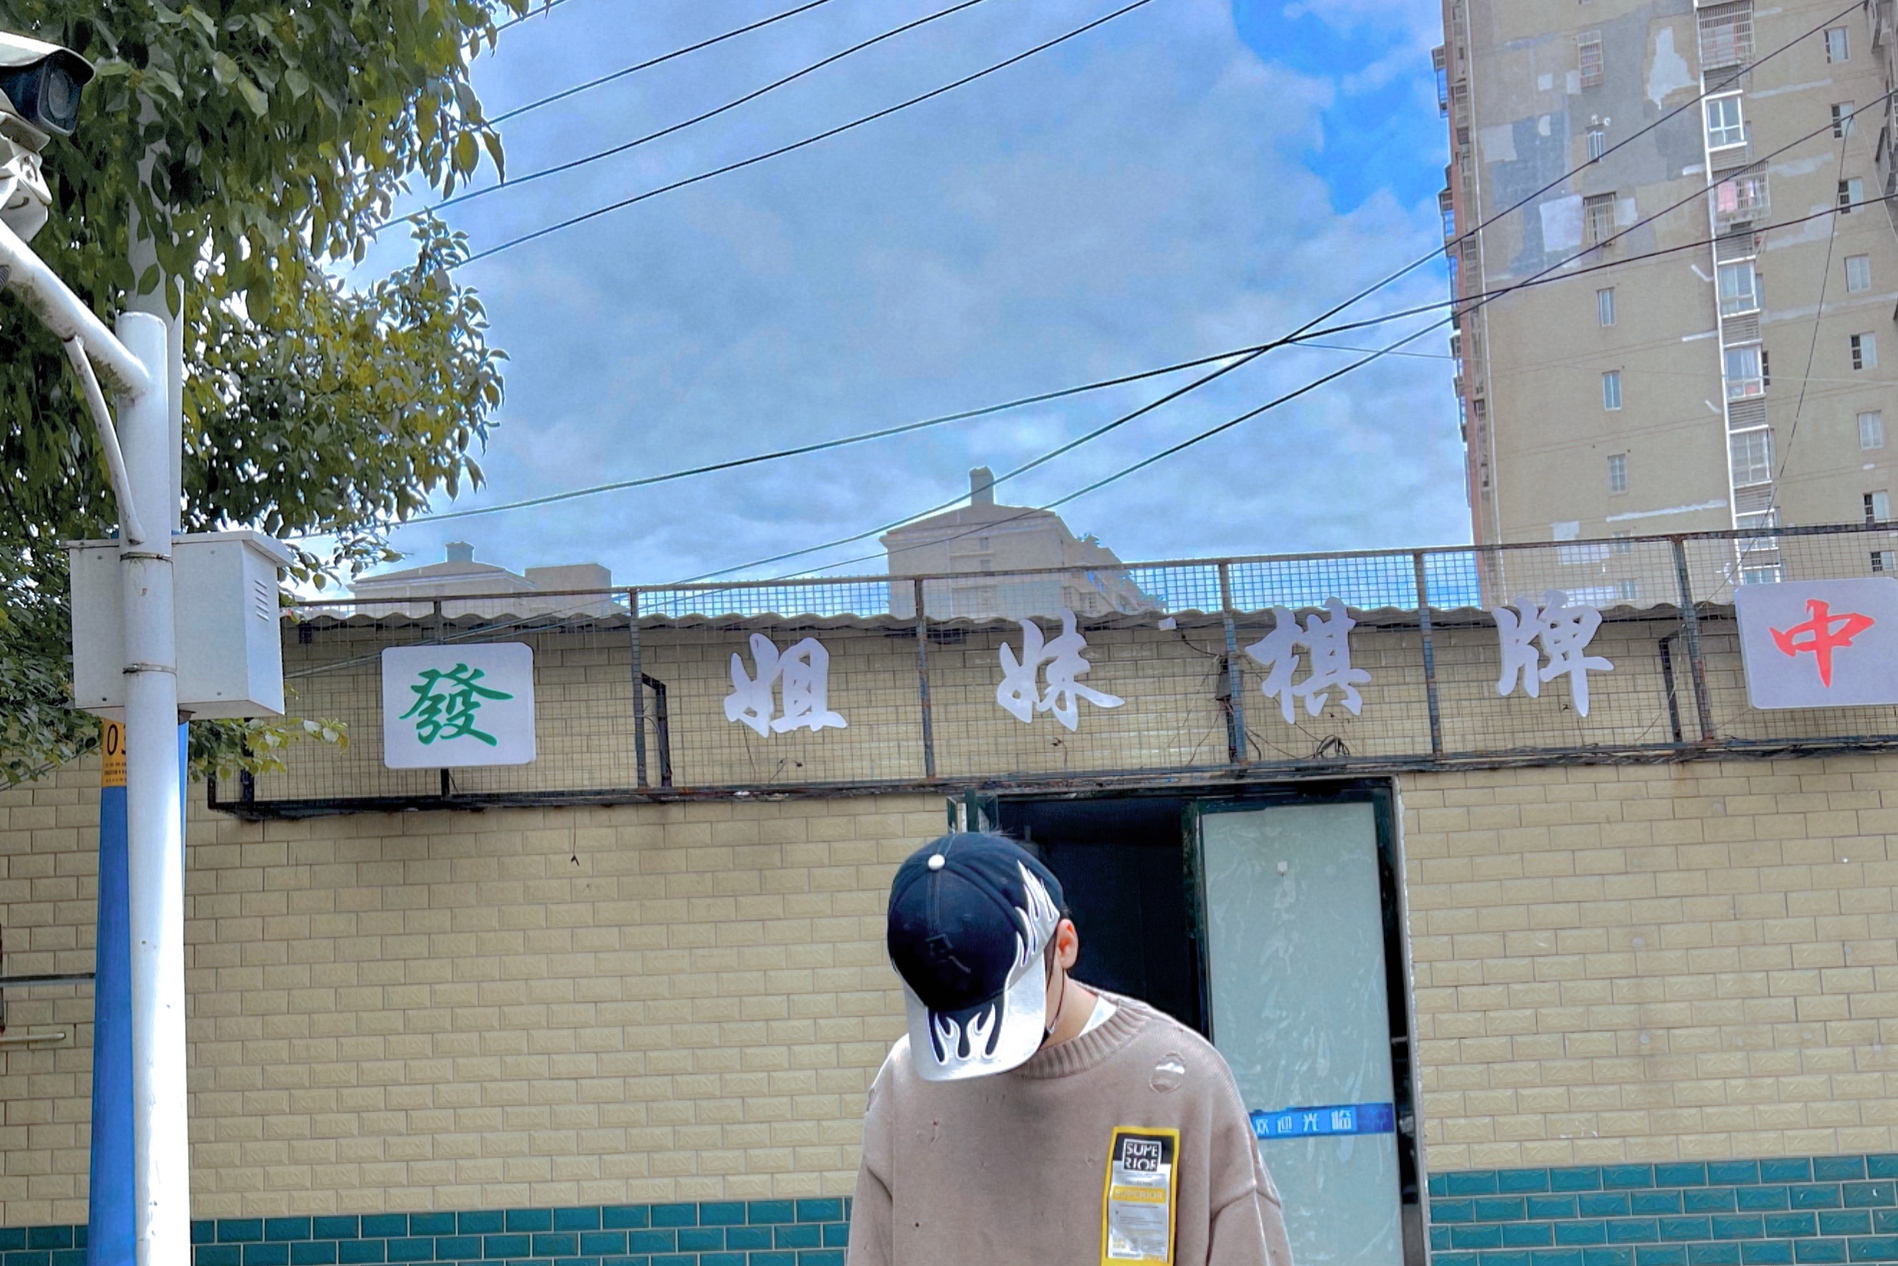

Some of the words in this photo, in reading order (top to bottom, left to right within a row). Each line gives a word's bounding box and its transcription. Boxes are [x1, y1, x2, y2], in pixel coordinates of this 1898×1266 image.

[724, 590, 1614, 737] 姐妹棋牌
[1768, 598, 1877, 690] 中
[106, 723, 126, 756] 0
[399, 662, 514, 748] 發
[1255, 1109, 1352, 1135] 欢迎光临
